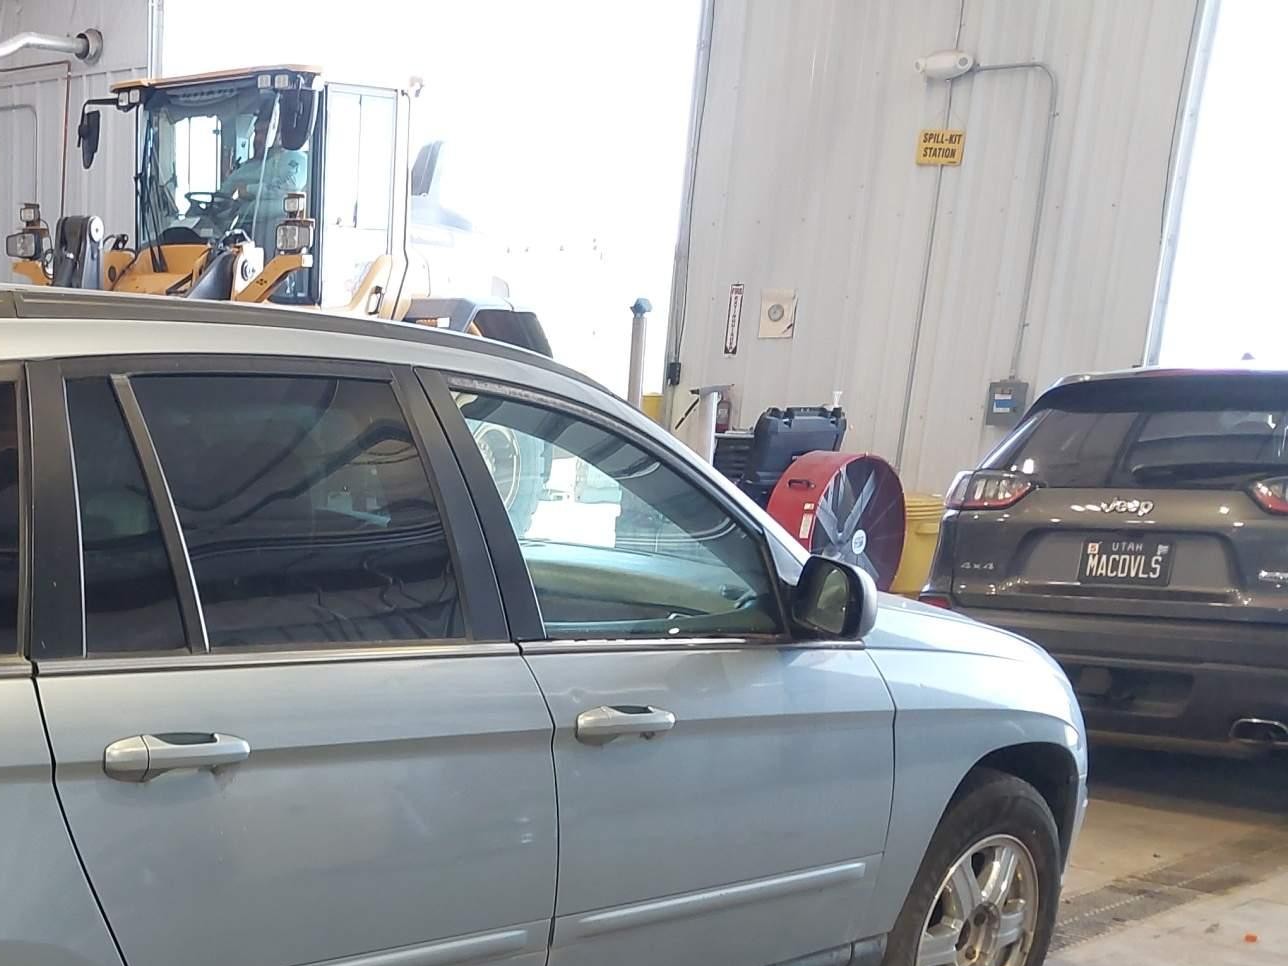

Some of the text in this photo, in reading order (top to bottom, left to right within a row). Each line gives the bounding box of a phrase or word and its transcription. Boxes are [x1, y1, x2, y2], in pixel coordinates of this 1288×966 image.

[923, 133, 963, 144] SPILL-KIT
[922, 147, 956, 158] STATION
[1100, 498, 1153, 517] Jeep
[1112, 542, 1143, 551] UTAH
